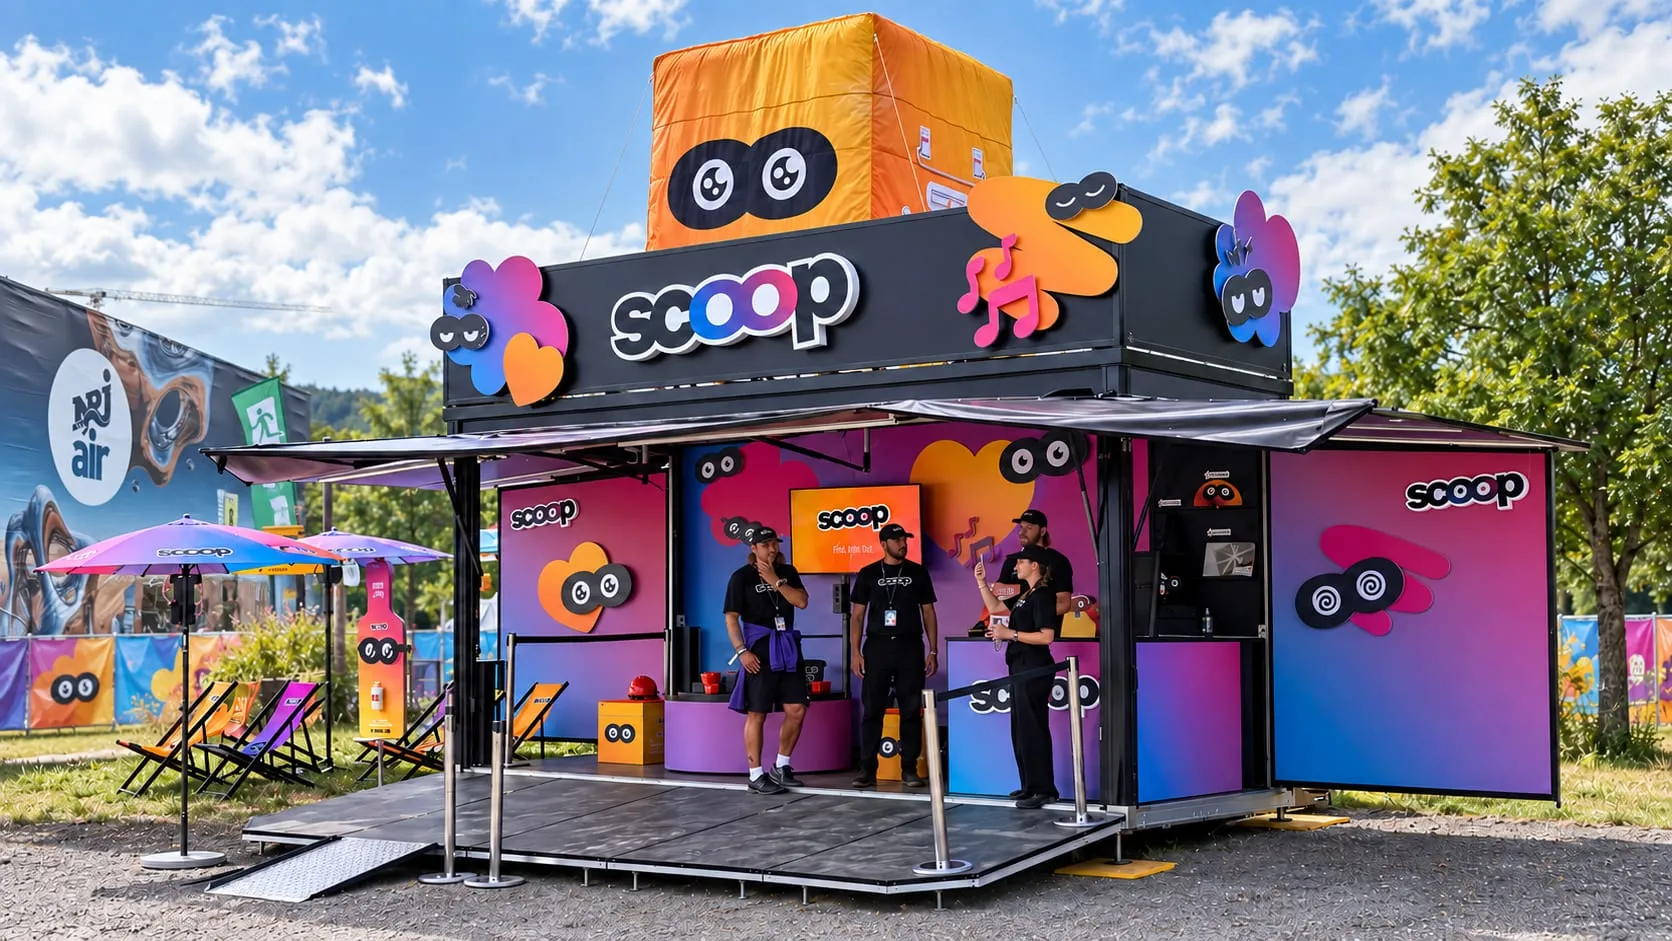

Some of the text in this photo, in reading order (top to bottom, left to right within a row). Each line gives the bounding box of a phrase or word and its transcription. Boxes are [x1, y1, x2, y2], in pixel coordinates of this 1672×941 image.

[612, 254, 855, 358] scoop
[72, 427, 110, 481] air
[1406, 472, 1527, 510] scoop
[511, 499, 577, 529] scoop
[818, 504, 889, 530] scoop
[158, 547, 232, 557] scoop
[969, 675, 1100, 717] scop
